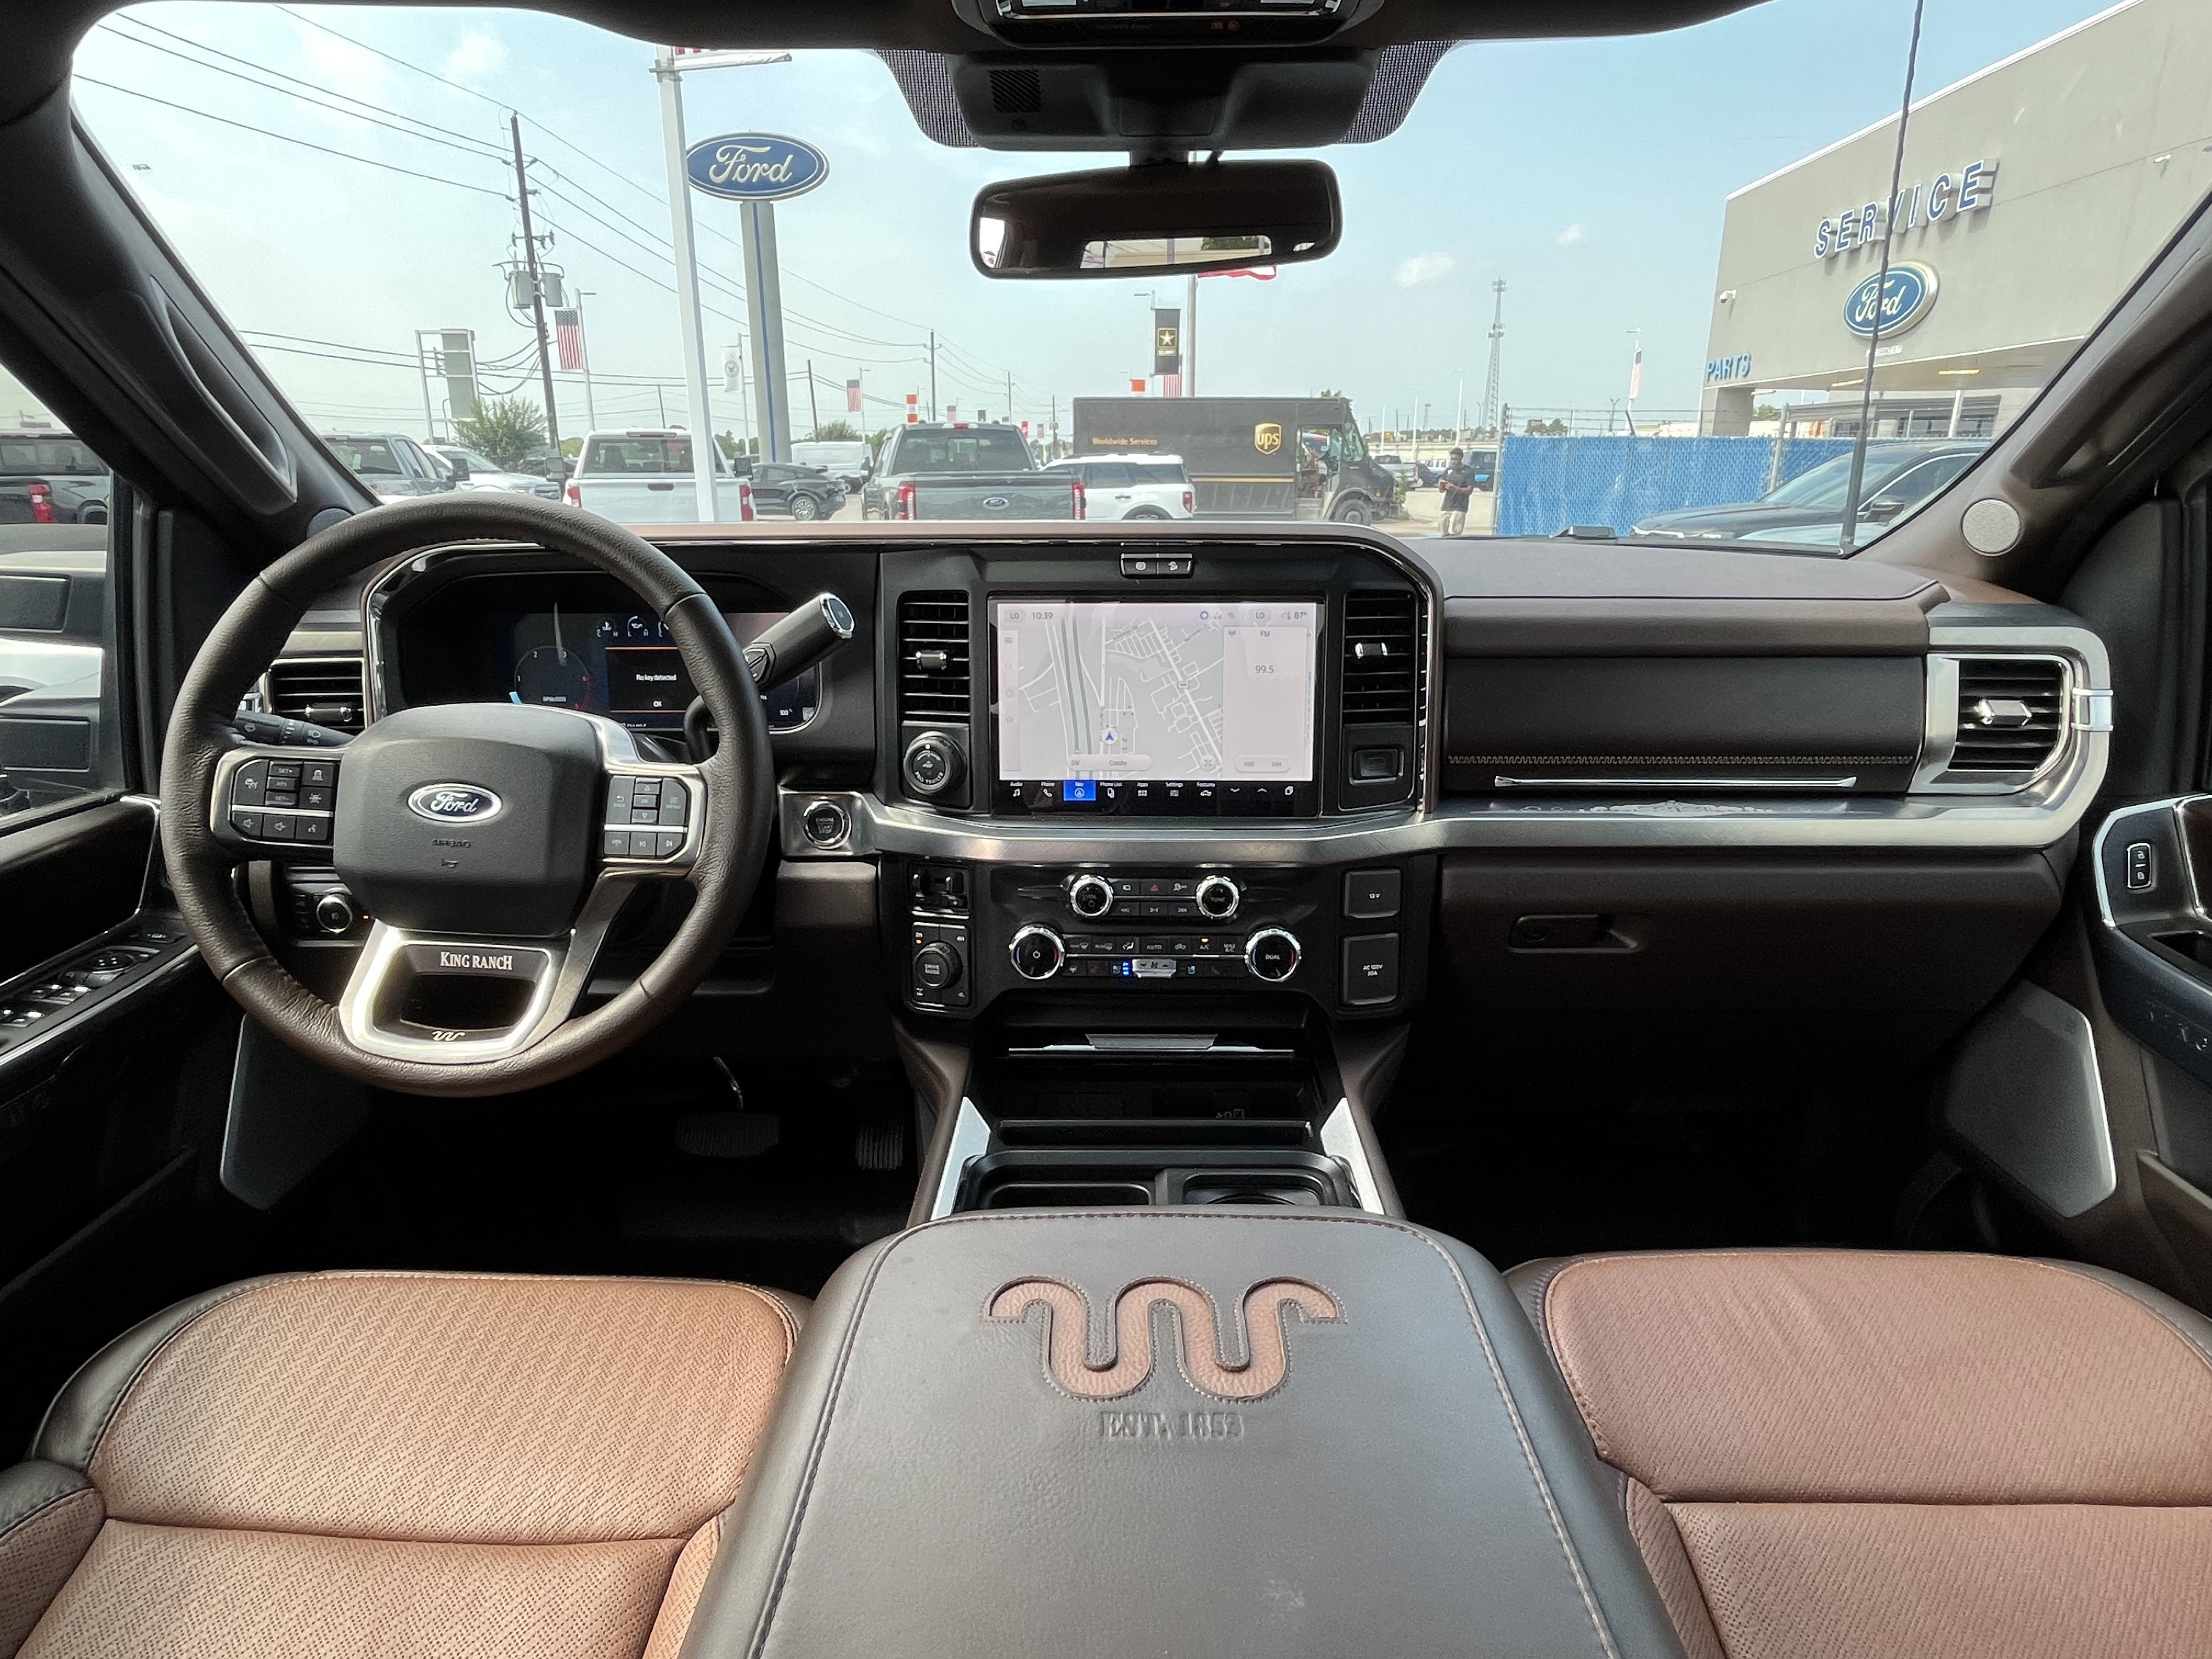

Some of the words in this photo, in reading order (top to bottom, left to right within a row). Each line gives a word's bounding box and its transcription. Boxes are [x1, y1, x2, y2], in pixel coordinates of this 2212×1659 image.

[709, 144, 793, 183] Ford
[1814, 159, 1991, 259] SERVICE
[1706, 352, 1751, 382] PARTS
[1092, 437, 1128, 445] Worldwide
[1130, 437, 1158, 445] Services
[1257, 433, 1279, 450] ups
[1031, 611, 1053, 619] 10:39
[1255, 665, 1274, 674] 99.5
[430, 791, 479, 813] Ford
[440, 951, 470, 968] KING
[472, 955, 512, 970] RANCH
[1178, 1410, 1244, 1438] 1853
